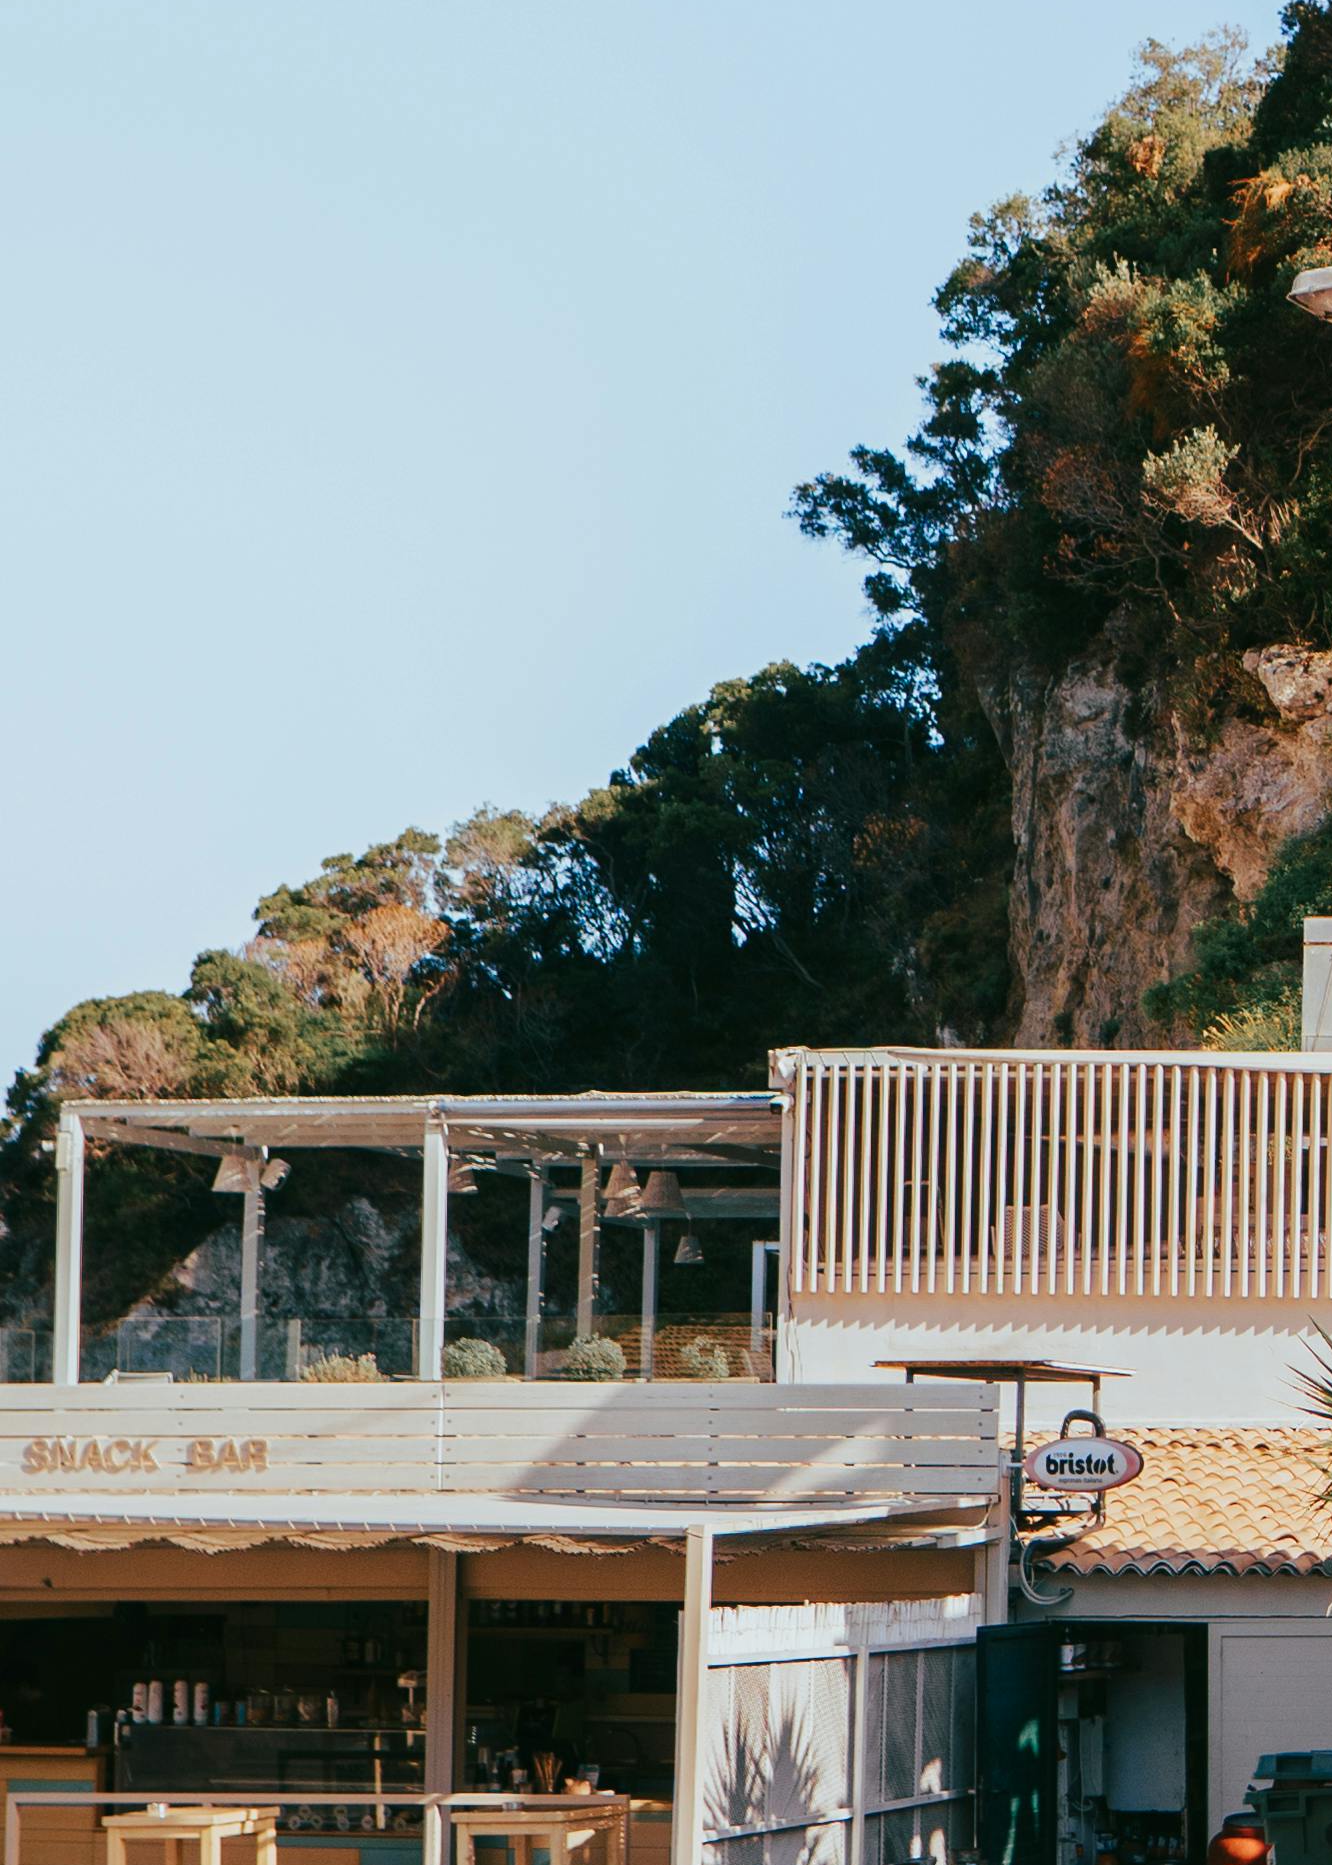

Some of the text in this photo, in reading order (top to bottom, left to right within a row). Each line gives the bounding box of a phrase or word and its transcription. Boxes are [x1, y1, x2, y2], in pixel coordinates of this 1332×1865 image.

[21, 1437, 269, 1474] SNACK BAR
[1045, 1452, 1116, 1475] bristot
